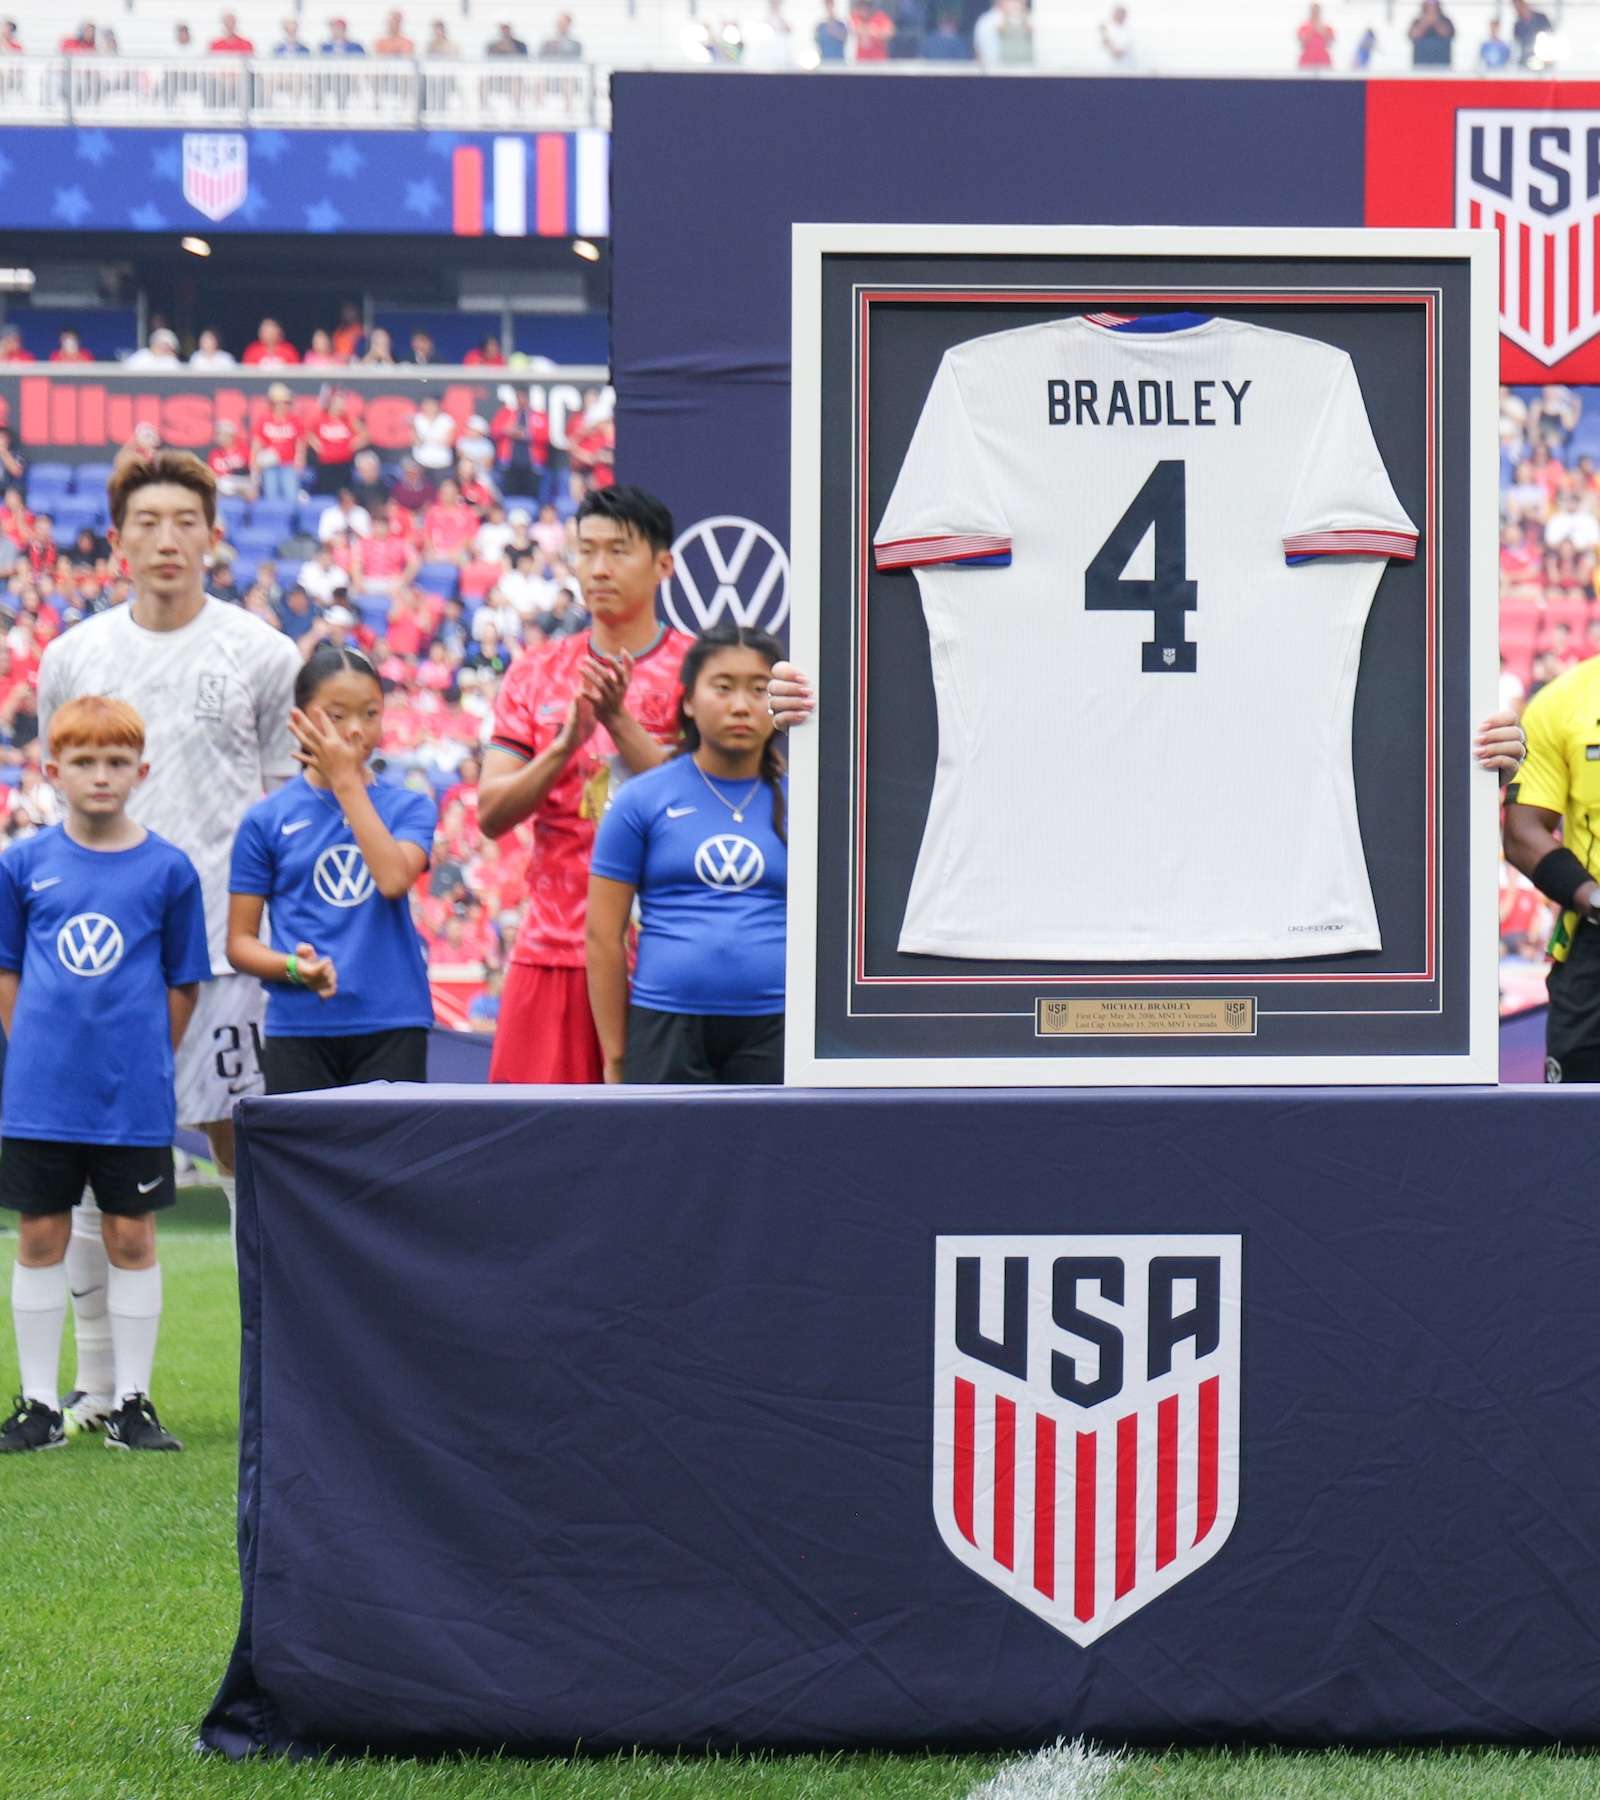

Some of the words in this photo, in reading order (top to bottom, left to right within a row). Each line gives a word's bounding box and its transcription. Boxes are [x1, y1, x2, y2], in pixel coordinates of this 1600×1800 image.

[1047, 379, 1252, 426] BRADLEY
[1084, 459, 1198, 673] 4
[955, 1256, 1221, 1409] USA
